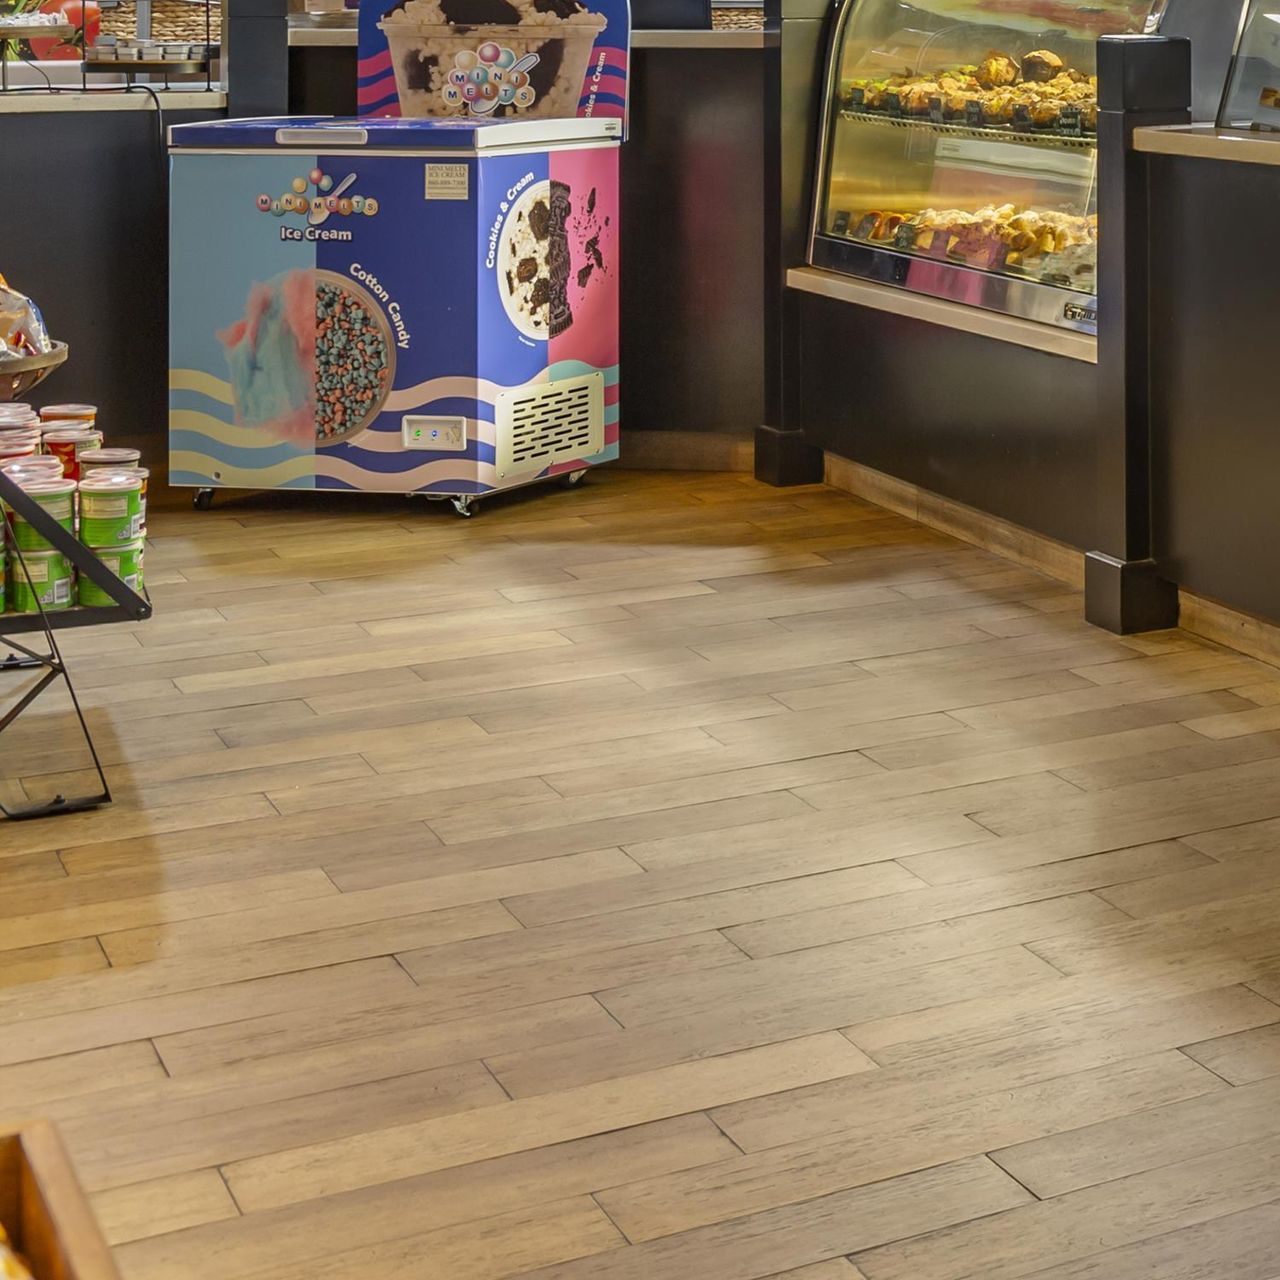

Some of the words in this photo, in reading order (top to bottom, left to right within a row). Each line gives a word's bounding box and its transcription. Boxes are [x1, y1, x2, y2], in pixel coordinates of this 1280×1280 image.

[447, 87, 529, 101] MELTS
[584, 95, 596, 118] okies
[593, 52, 607, 83] Cream
[260, 197, 304, 210] MINI
[313, 199, 375, 212] MELTS
[486, 214, 503, 269] Cookies
[500, 201, 509, 212] &
[506, 172, 535, 201] Cream
[280, 226, 302, 240] Ice
[305, 226, 353, 241] Cream
[349, 263, 389, 303] Cotton
[387, 301, 411, 350] Candy
